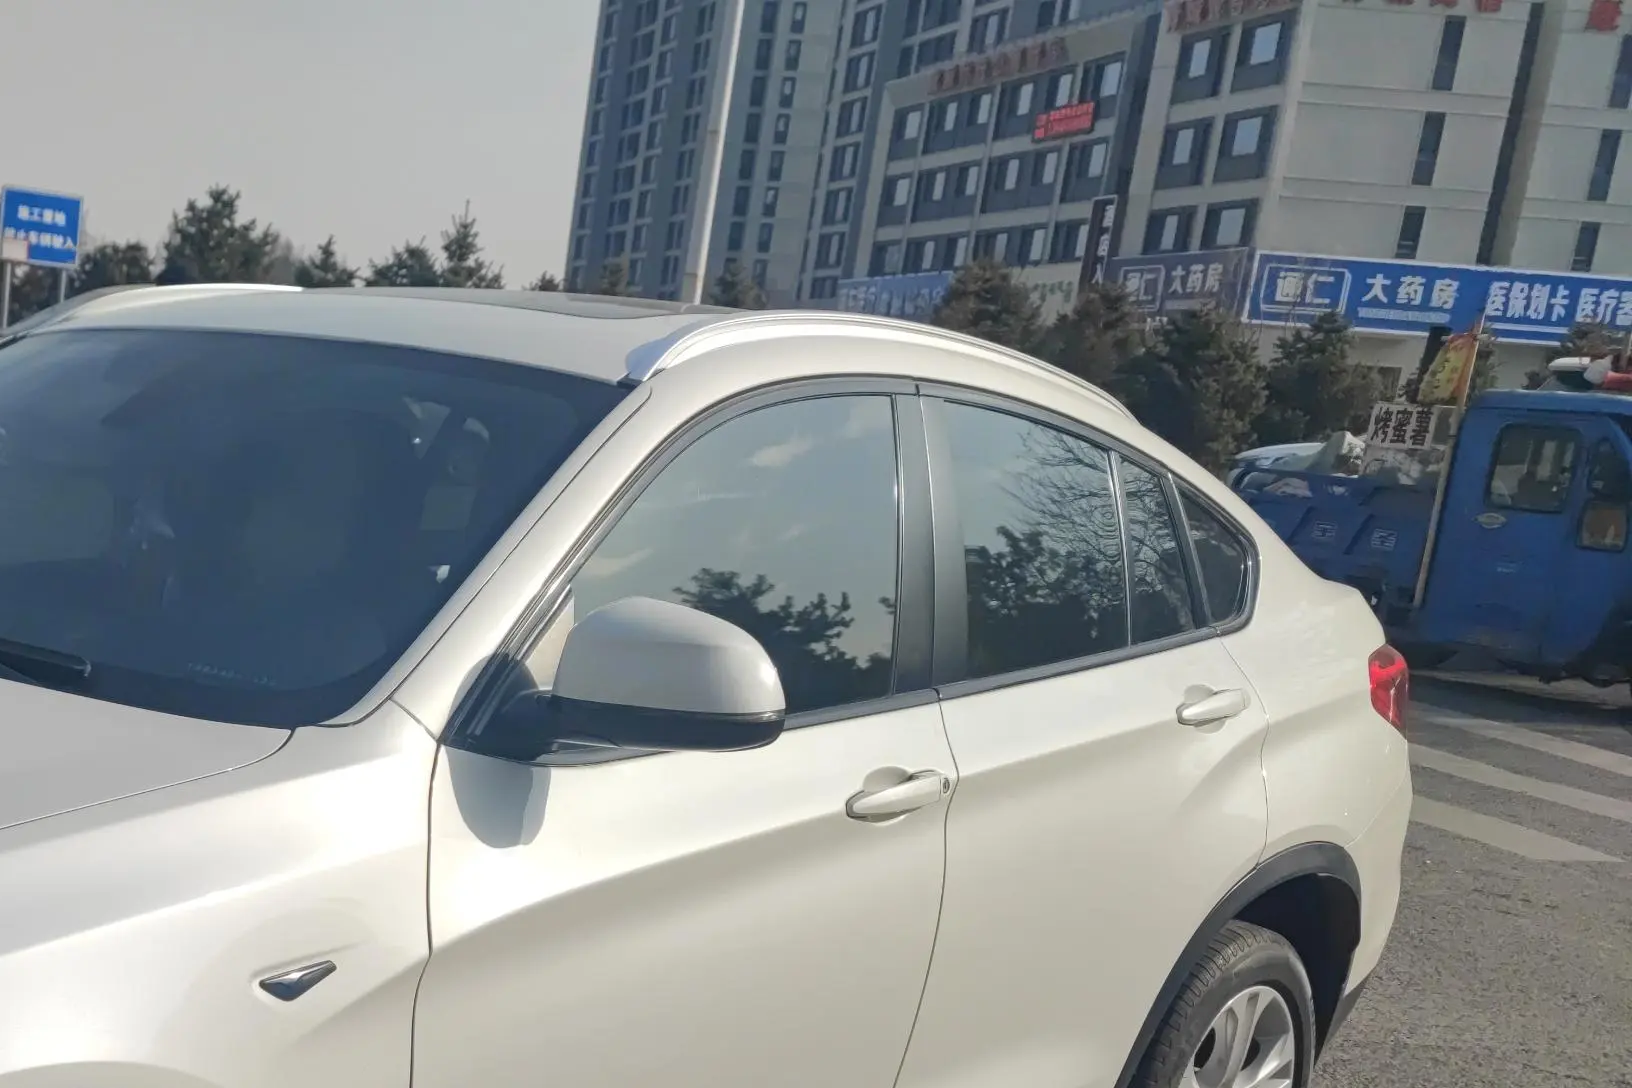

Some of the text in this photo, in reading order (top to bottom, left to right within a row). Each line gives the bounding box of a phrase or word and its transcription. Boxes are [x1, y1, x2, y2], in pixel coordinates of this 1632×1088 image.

[1168, 263, 1224, 294] 大药房
[1361, 273, 1460, 309] 大药房
